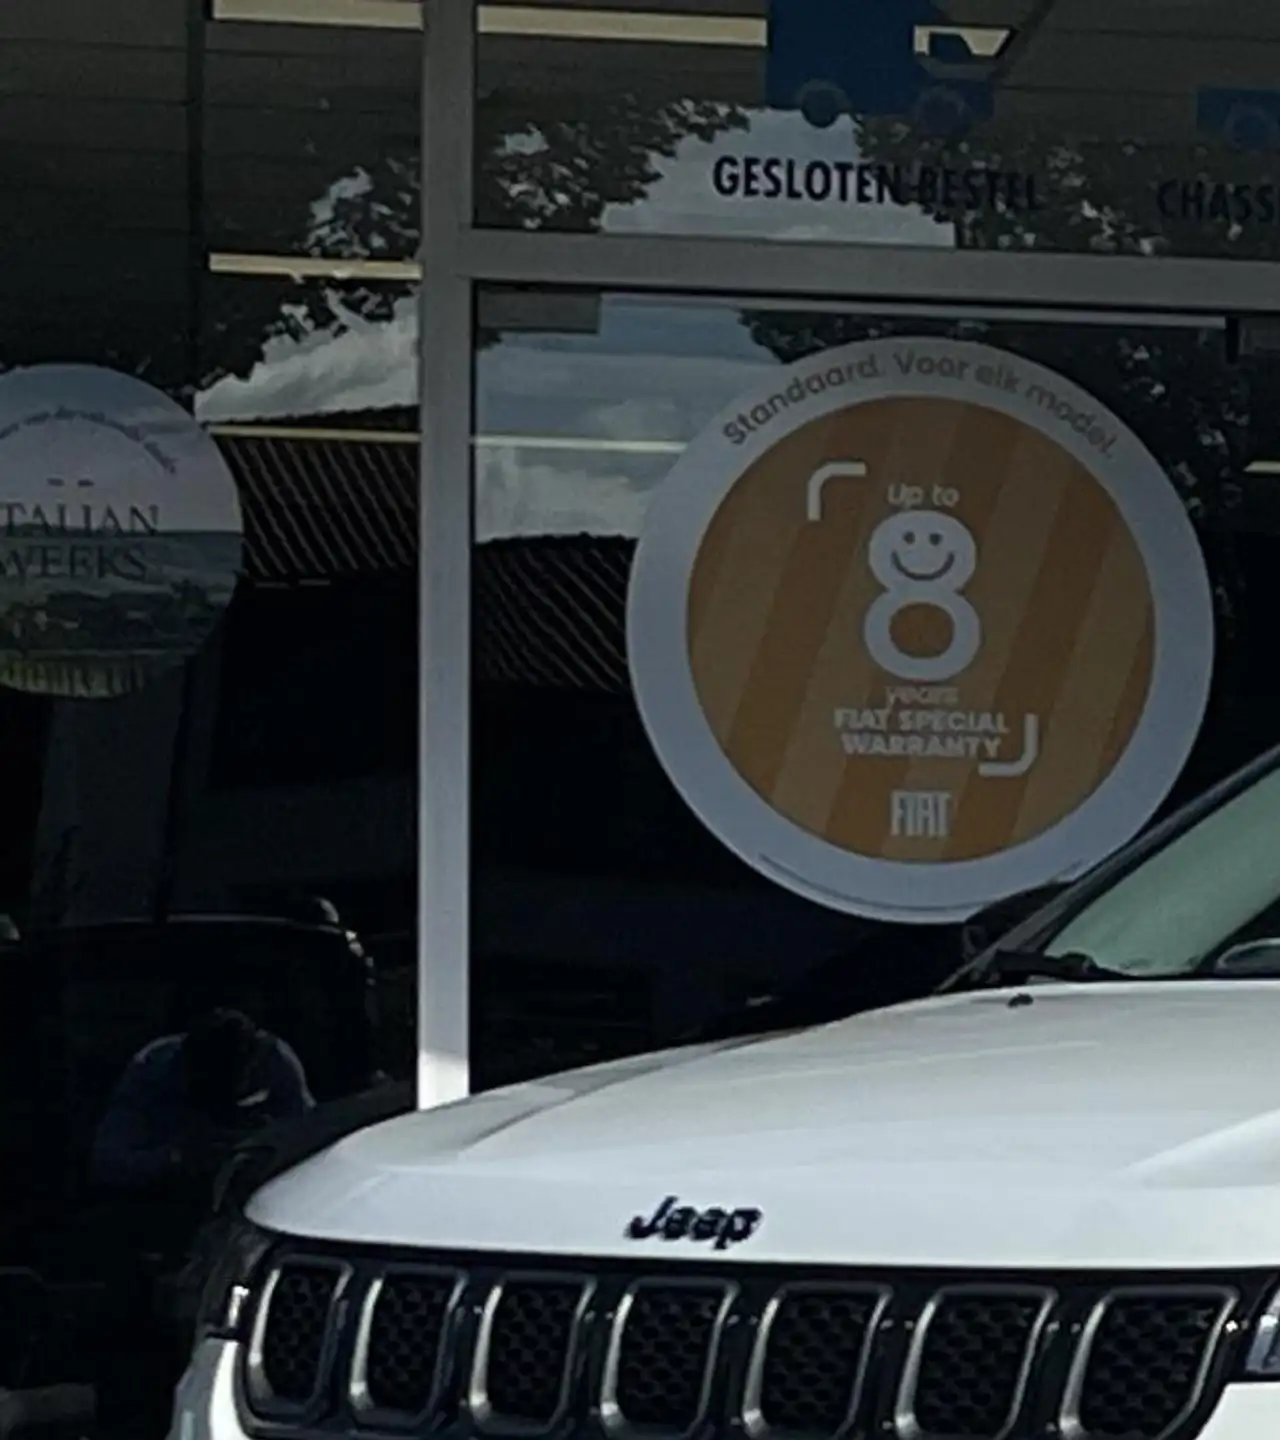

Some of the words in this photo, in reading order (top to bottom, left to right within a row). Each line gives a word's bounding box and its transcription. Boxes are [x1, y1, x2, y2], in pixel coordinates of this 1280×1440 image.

[712, 155, 905, 206] GESLOTEN
[918, 164, 1043, 211] BESTEL
[892, 349, 970, 379] Voor
[975, 363, 1021, 395] elk
[887, 483, 924, 508] Up
[931, 484, 960, 507] to
[833, 707, 888, 731] FIAT
[897, 710, 1010, 734] SPECIAL
[841, 732, 1002, 758] WARRANTY
[890, 790, 952, 837] FIAT
[624, 1196, 762, 1250] Jeep
